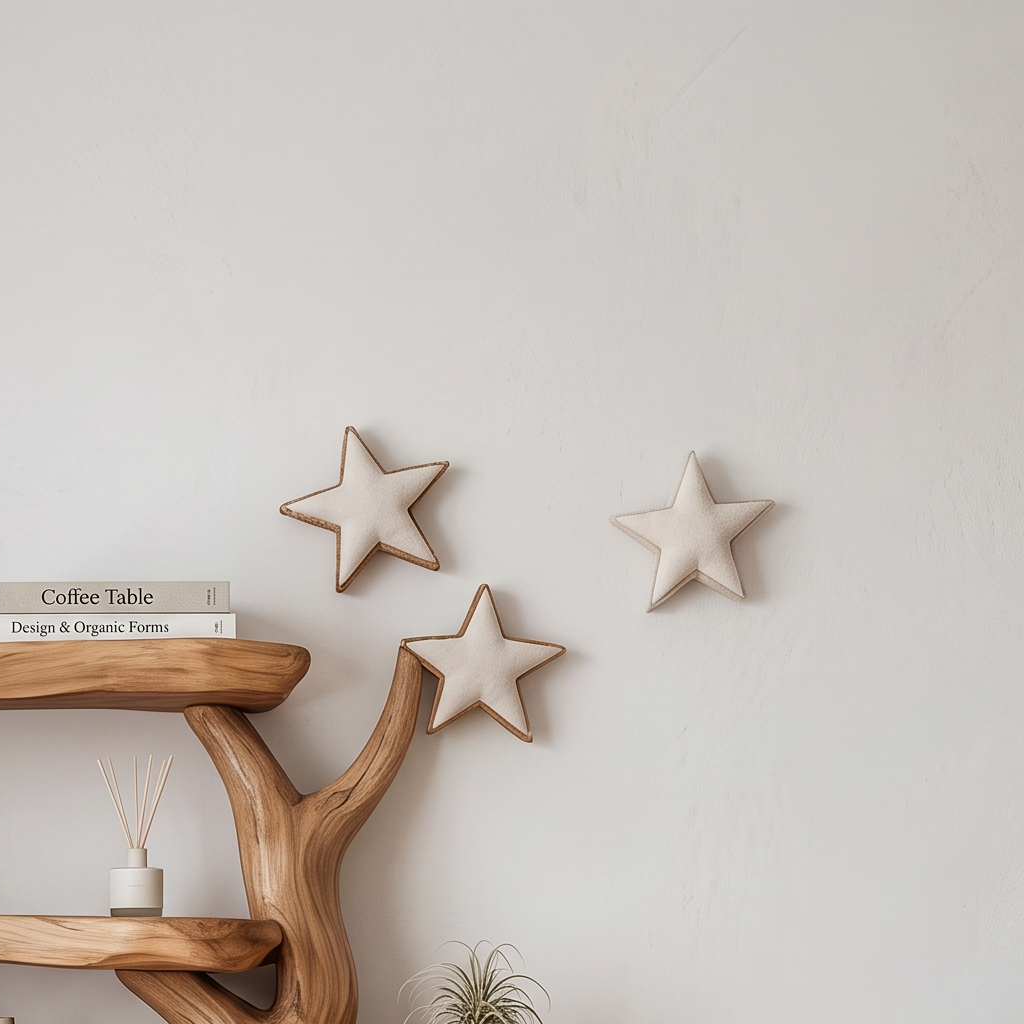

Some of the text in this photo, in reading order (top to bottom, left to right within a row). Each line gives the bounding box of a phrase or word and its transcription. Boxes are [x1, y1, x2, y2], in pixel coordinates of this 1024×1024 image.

[41, 587, 154, 606] Coffee Table
[11, 620, 170, 637] Design & Organic Forms
